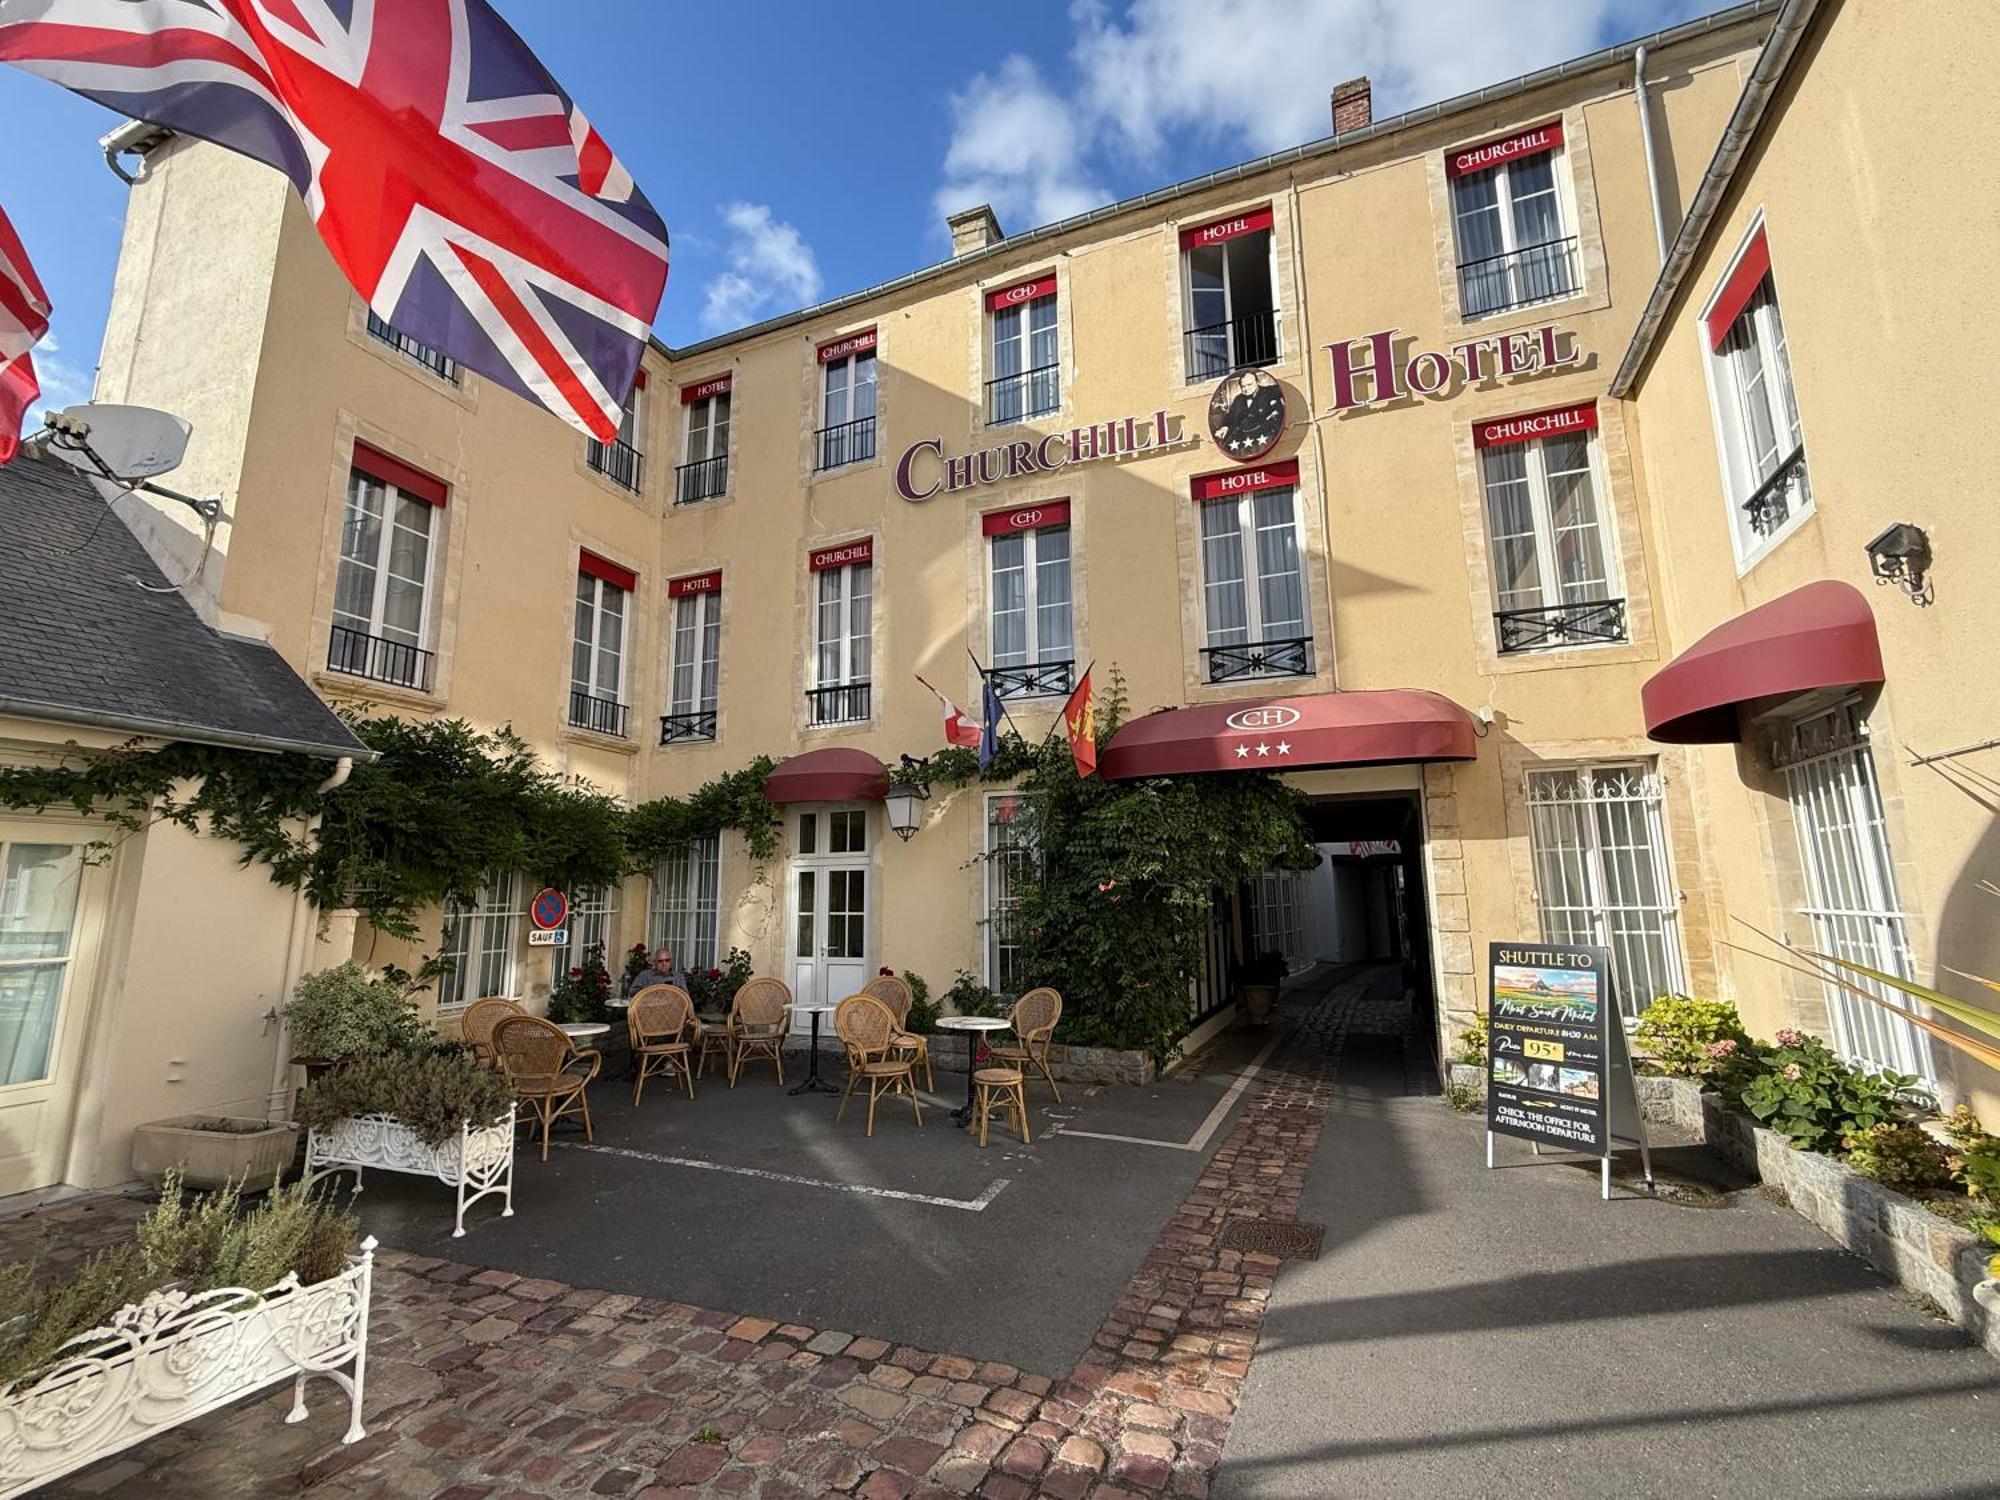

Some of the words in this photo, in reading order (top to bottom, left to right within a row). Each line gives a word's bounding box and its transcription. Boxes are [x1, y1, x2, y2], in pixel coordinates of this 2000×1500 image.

[1456, 131, 1549, 169] CHURCHILL
[1203, 218, 1249, 241] HOTEL
[1011, 284, 1031, 300] CH
[822, 333, 875, 358] CHURCHILL
[697, 381, 726, 396] HOTEL
[895, 408, 1185, 502] CHURCHILL
[1320, 323, 1580, 413] HOTEL
[1484, 410, 1585, 440] CHURCHILL
[1220, 471, 1270, 490] HOTEL
[1015, 511, 1036, 525] CH
[815, 545, 870, 566] CHURCHILL
[682, 577, 712, 592] HOTEL
[1241, 709, 1283, 726] CH
[531, 932, 553, 942] SAUF
[1499, 949, 1565, 967] SHUTTLE
[1567, 953, 1593, 968] TO
[1494, 1022, 1515, 1031] DAILY
[1516, 1024, 1560, 1037] DEPARTURE
[1495, 1114, 1545, 1132] AFTERNOON
[1546, 1125, 1597, 1143] DEPARTURE
[1498, 1106, 1526, 1119] CHECK
[1527, 1111, 1543, 1123] THE
[1543, 1115, 1573, 1129] OFFICE
[1573, 1121, 1592, 1133] FOR
